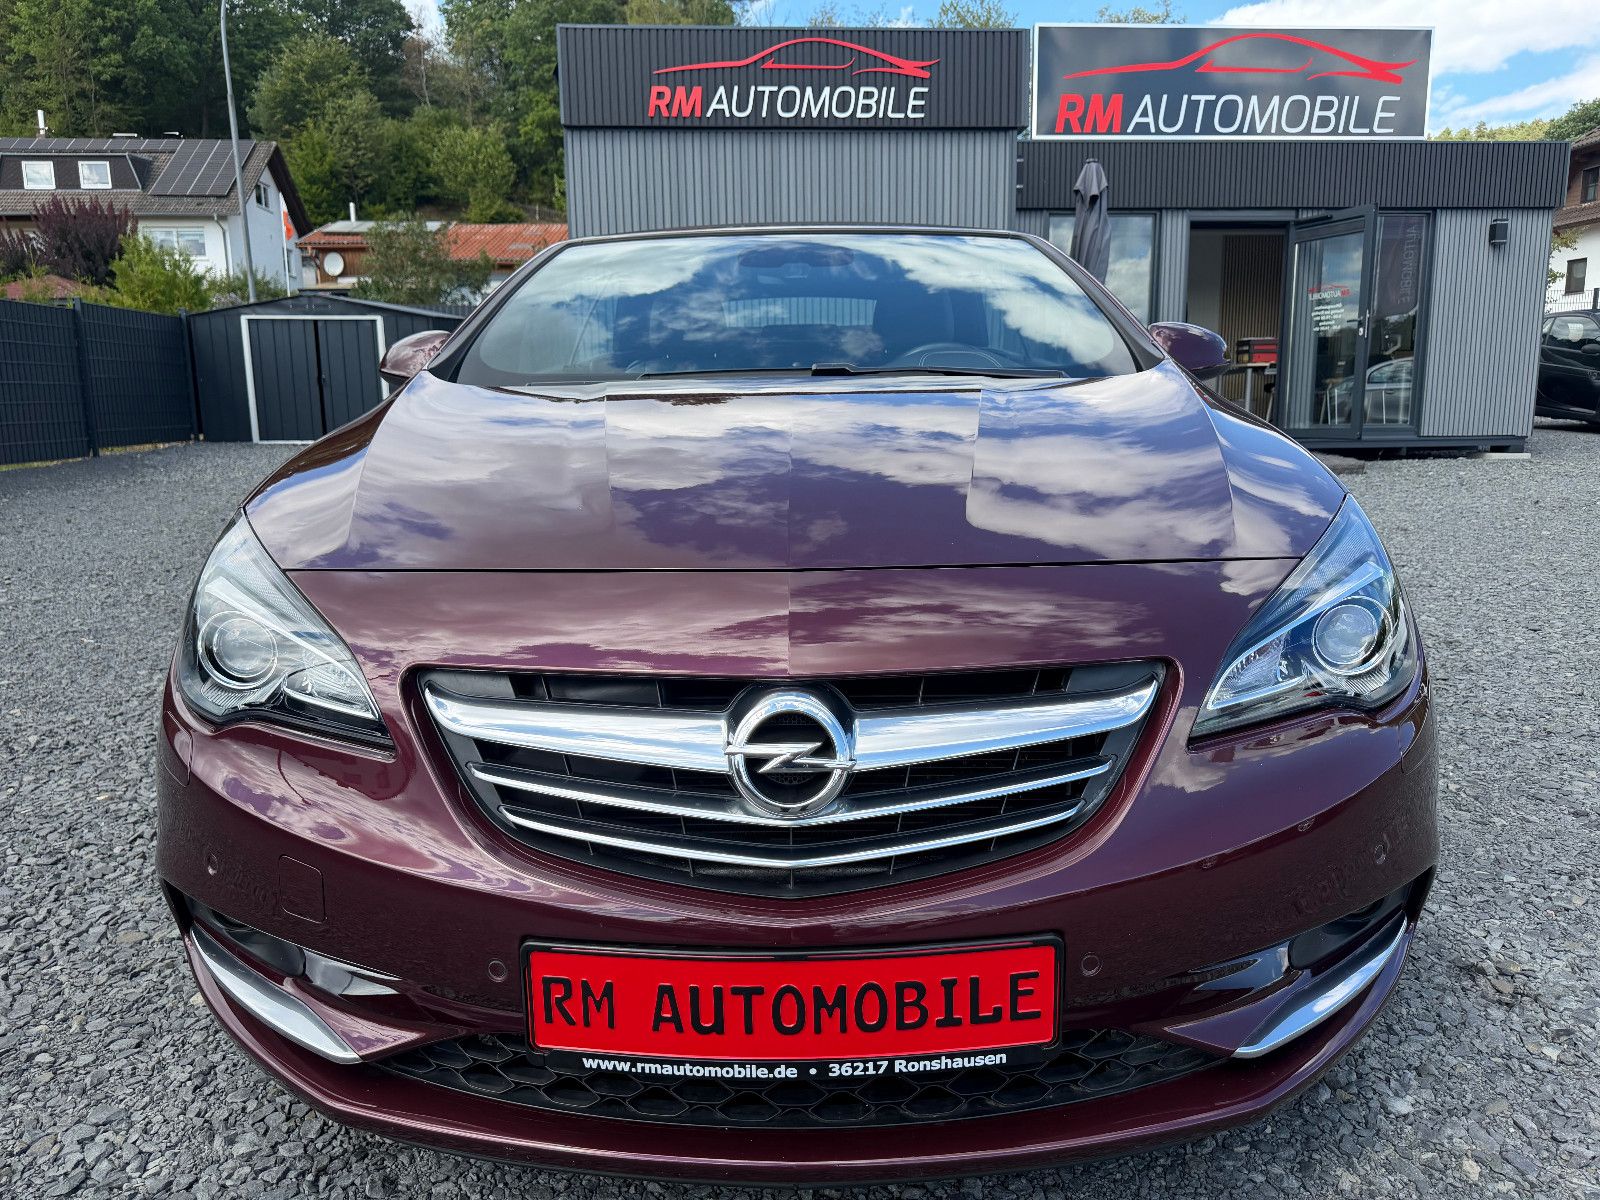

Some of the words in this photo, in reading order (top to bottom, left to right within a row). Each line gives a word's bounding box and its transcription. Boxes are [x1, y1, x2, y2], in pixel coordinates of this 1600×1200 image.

[648, 85, 702, 118] RM
[706, 85, 929, 118] AUTOMOBILE
[1054, 93, 1123, 134] RM
[1126, 94, 1401, 134] AUTOMOBILE
[541, 975, 616, 1029] RM
[652, 970, 1042, 1035] AUTOMOBILE
[582, 1057, 798, 1078] www.rmautomobile.de
[828, 1060, 889, 1077] 36217
[894, 1052, 1007, 1073] Ronshausen
